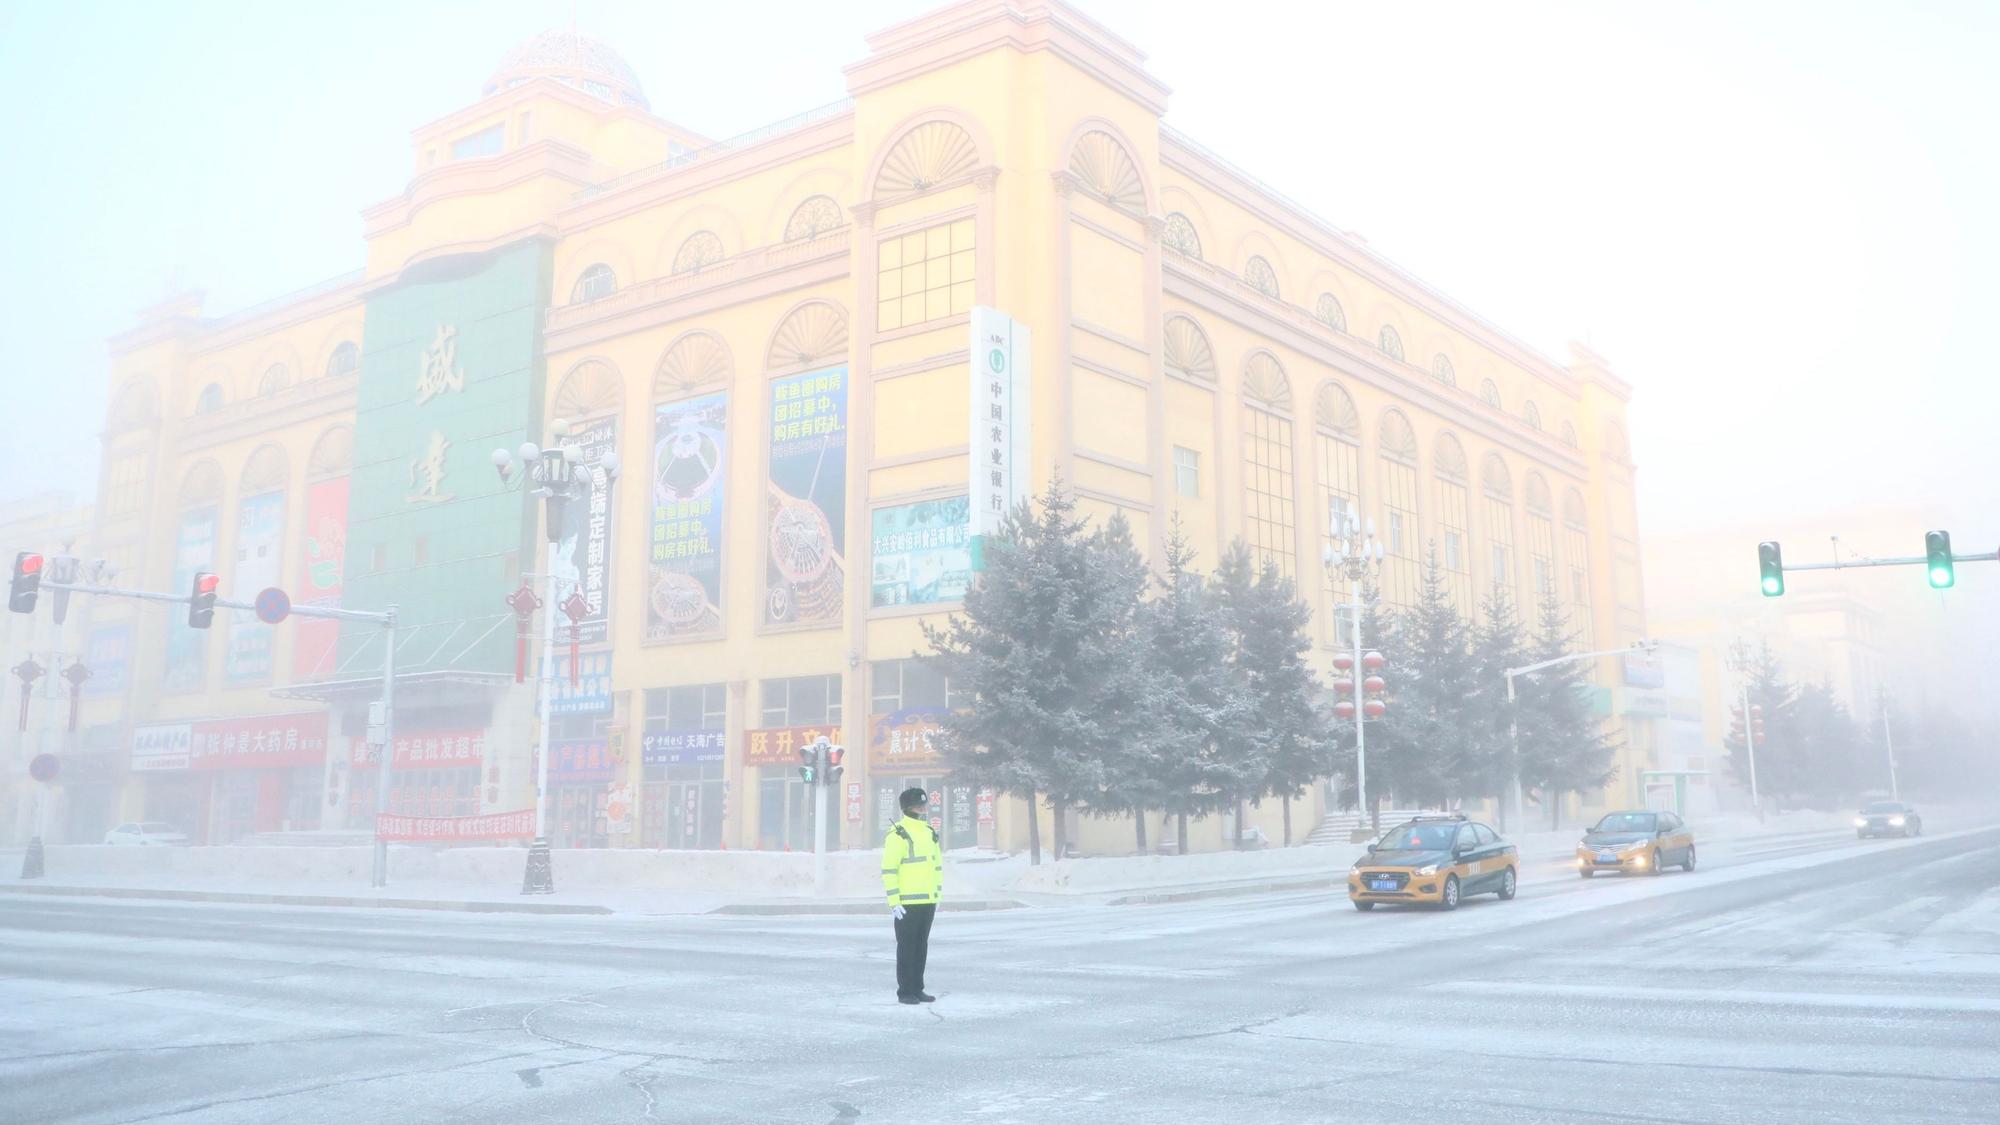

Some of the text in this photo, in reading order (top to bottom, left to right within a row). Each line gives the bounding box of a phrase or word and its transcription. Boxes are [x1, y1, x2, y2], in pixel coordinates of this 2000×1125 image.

[991, 382, 1004, 511] 中国农业银行
[207, 728, 298, 756] 张仲景大药房
[848, 784, 861, 820] 早餐
